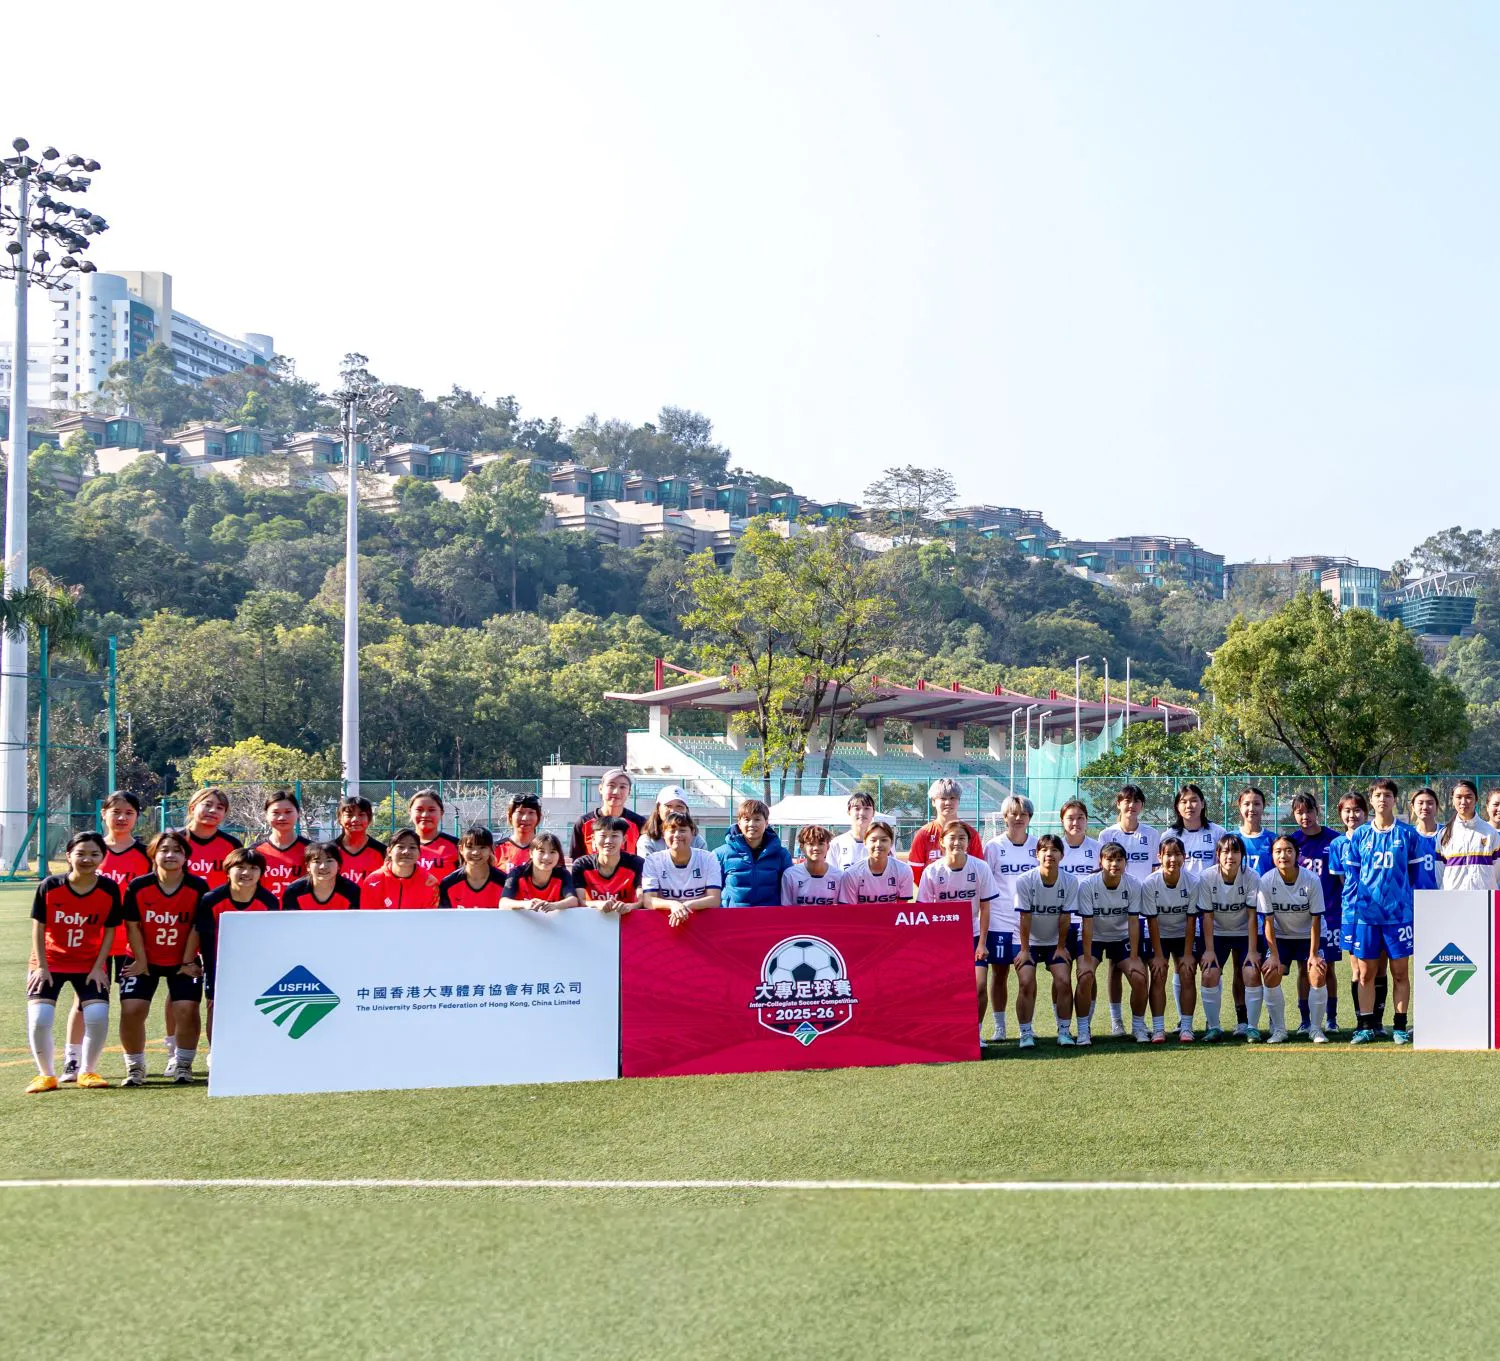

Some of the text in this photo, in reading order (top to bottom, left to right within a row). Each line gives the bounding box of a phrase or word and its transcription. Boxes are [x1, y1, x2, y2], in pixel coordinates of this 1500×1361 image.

[1124, 852, 1149, 861] UGS
[1185, 850, 1214, 860] UGS
[1373, 851, 1394, 870] 20
[1059, 865, 1094, 873] UGS
[1424, 854, 1435, 871] 8
[857, 893, 897, 903] BUGS
[939, 889, 976, 900] BUGS
[1093, 906, 1129, 915] BUGS
[1156, 905, 1189, 914] BUGS
[1212, 902, 1247, 911] BUGS
[1272, 902, 1310, 911] BUGS
[55, 910, 99, 926] PolyU
[145, 910, 189, 926] PolyU
[895, 912, 960, 926] AIA 全力支持
[67, 928, 84, 948] 12
[156, 928, 178, 946] 22
[1398, 926, 1413, 942] 20
[996, 945, 1004, 958] 11
[278, 982, 320, 992] USFHK
[357, 982, 582, 1000] 中國香港大專體育協會有限公司
[755, 980, 852, 1000] 大專足球賽
[356, 1004, 371, 1012] The
[372, 1003, 410, 1012] University
[412, 1002, 437, 1011] Sports
[438, 1001, 478, 1009] Federation
[488, 1000, 508, 1009] Hong
[509, 999, 531, 1008] Kong,
[531, 999, 553, 1007] China
[553, 998, 581, 1007] Limited
[775, 1007, 835, 1021] 2025-26
